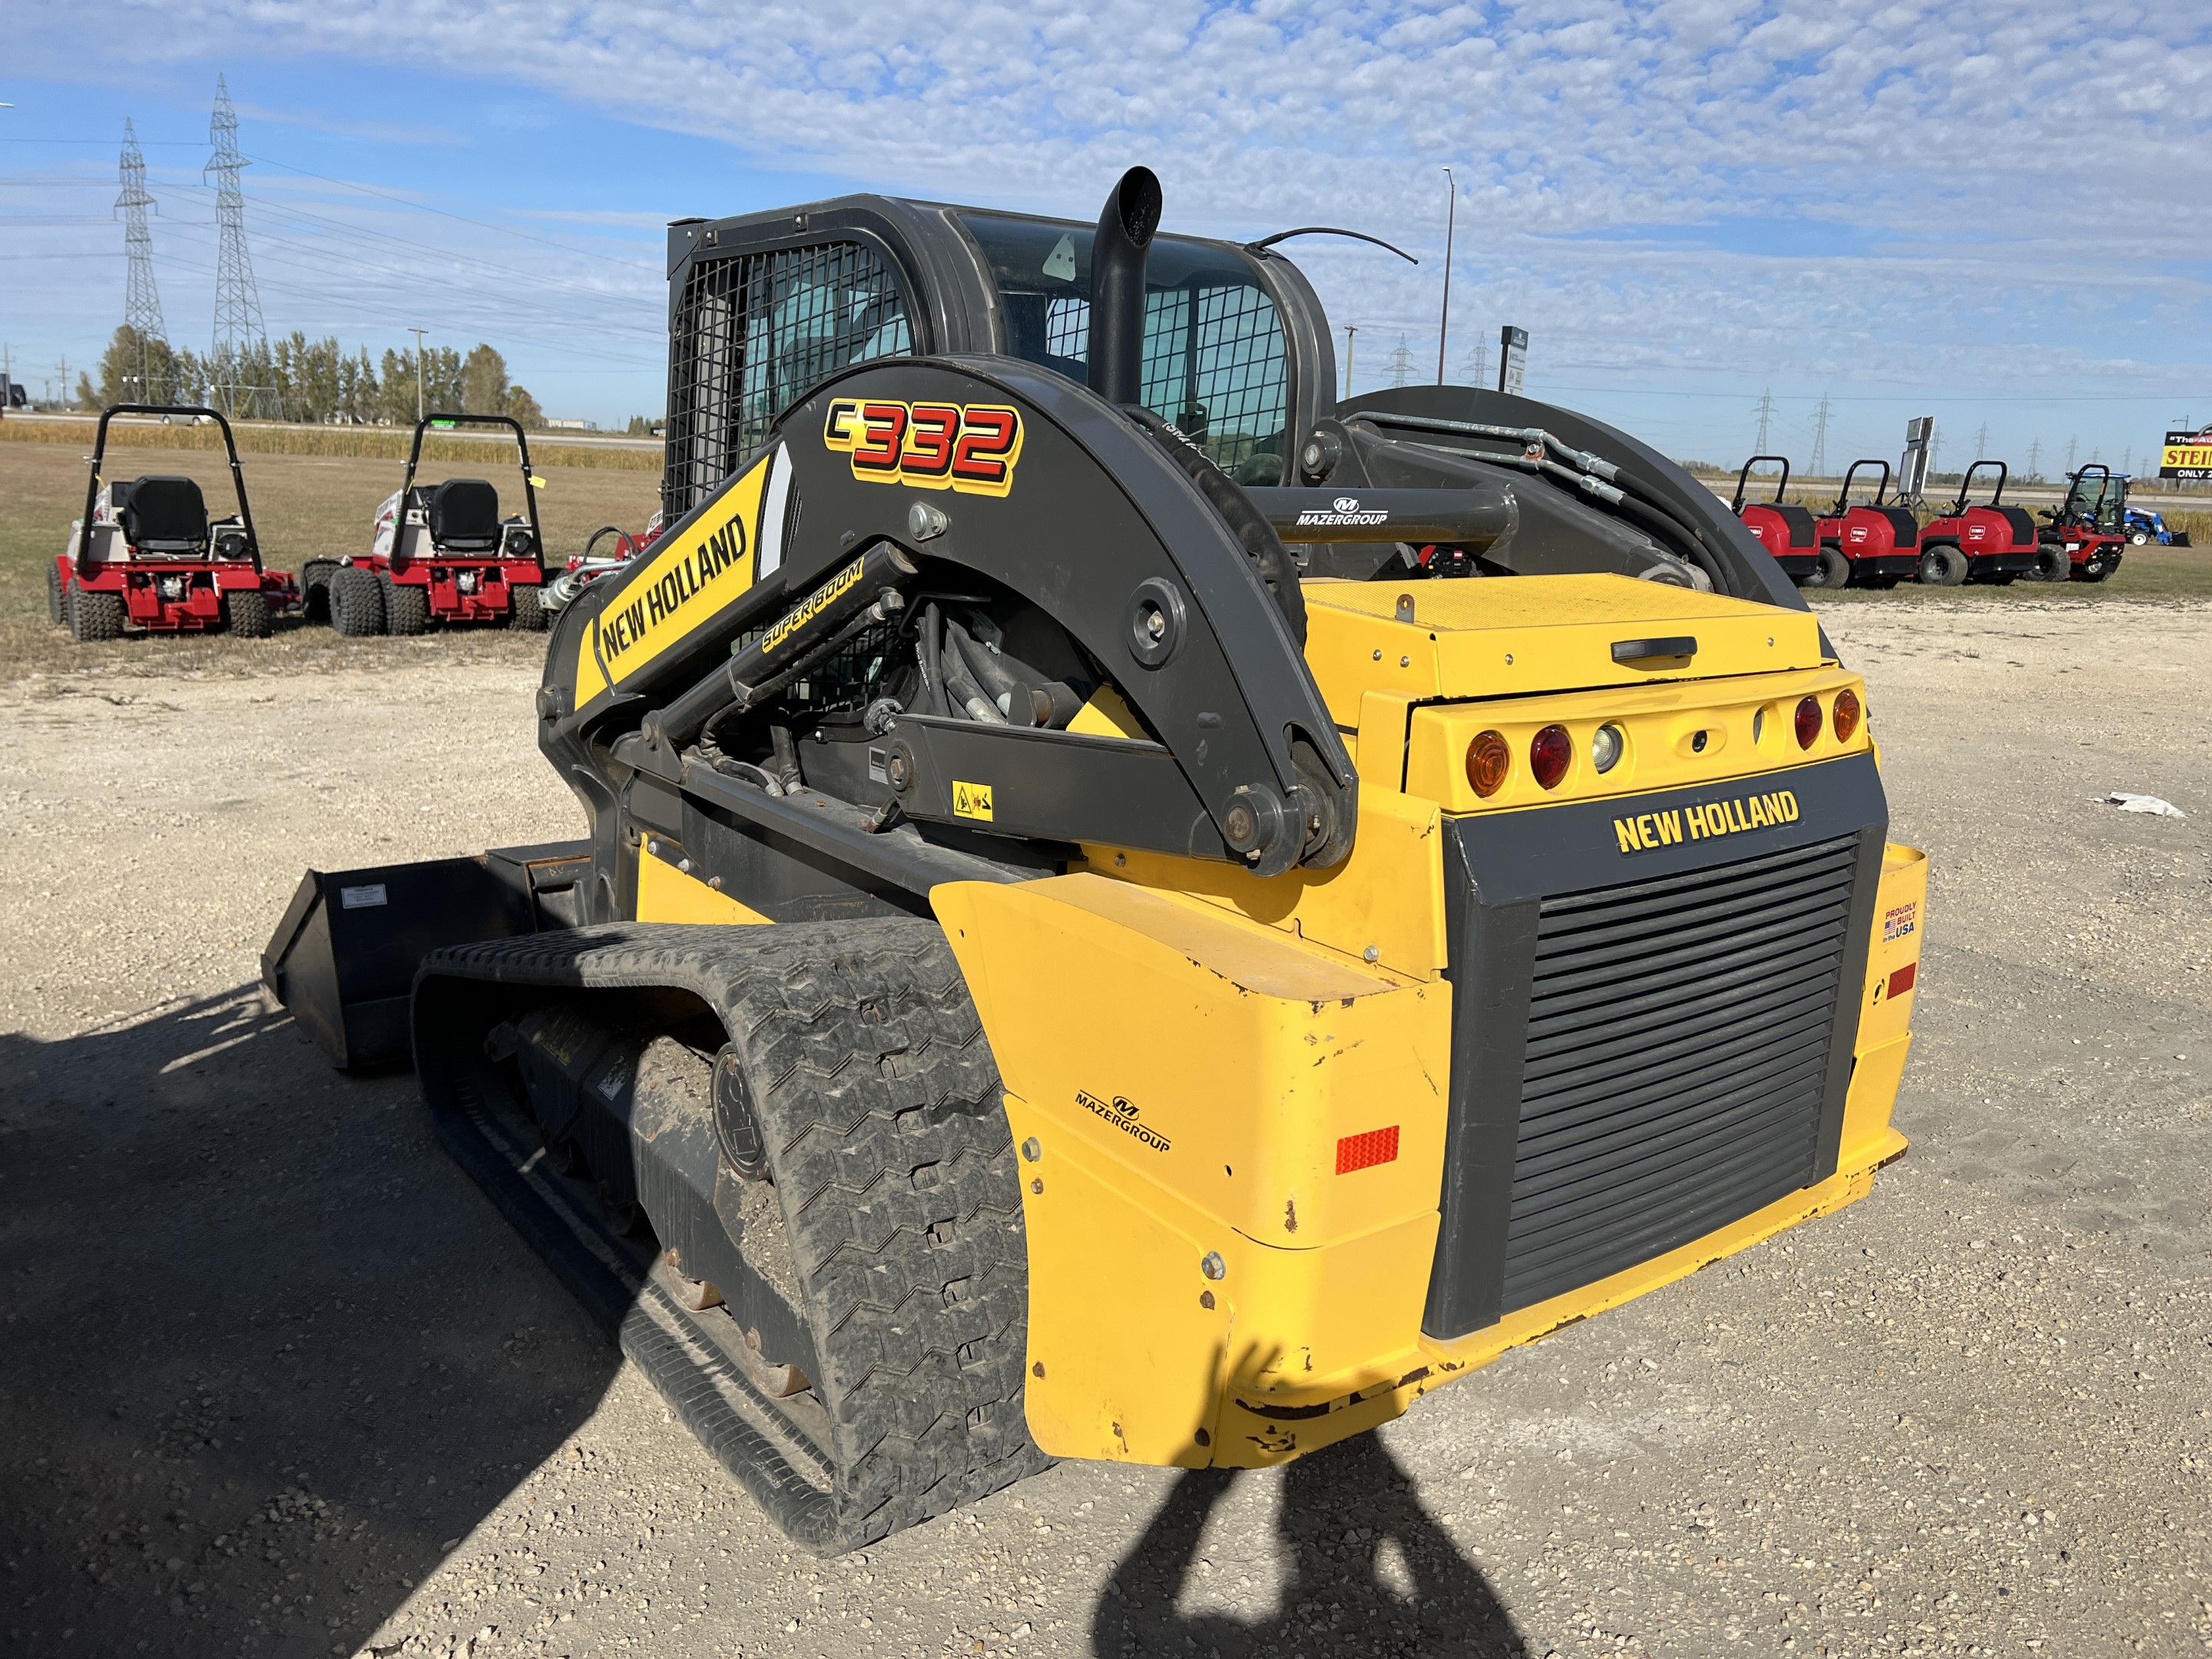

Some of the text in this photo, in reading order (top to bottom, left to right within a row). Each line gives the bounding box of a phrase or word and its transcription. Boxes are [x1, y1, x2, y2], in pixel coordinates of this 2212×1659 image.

[826, 400, 1020, 487] C332
[2177, 469, 2205, 478] ONLY
[1296, 514, 1388, 525] MAZERGROUP
[601, 512, 747, 664] NEW HOLLAND
[763, 557, 864, 651] SUPER BOOM
[1614, 790, 1799, 853] NEW HOLLAND
[1886, 901, 1916, 919] PROUDLY
[1897, 911, 1916, 926] BUILT
[1896, 922, 1914, 938] USA
[1075, 1093, 1171, 1152] MAZERGROUP
